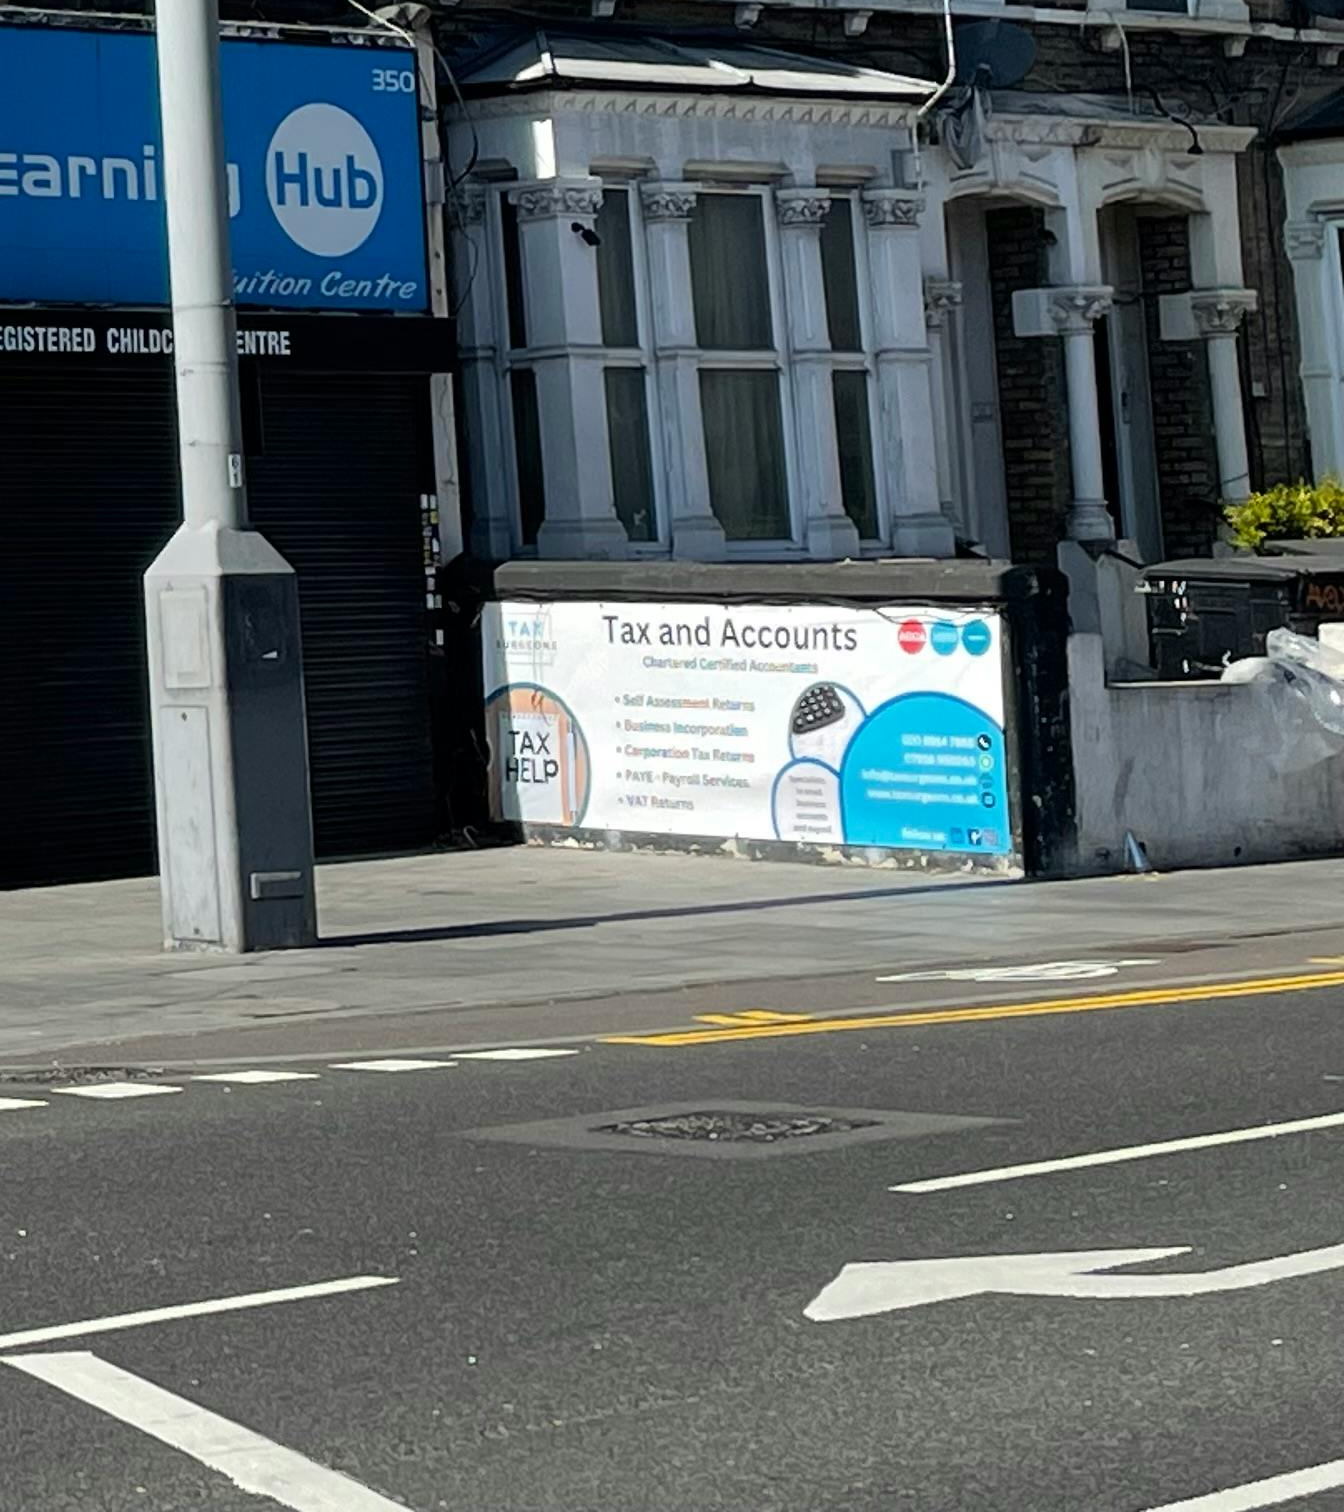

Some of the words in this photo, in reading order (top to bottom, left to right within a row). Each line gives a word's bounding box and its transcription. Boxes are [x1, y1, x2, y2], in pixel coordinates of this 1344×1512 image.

[372, 68, 415, 92] 350
[274, 151, 378, 210] Hub
[232, 268, 312, 296] uition
[320, 270, 418, 300] Centre
[106, 327, 174, 354] CHILDC
[237, 330, 292, 356] ENTRE
[507, 619, 544, 638] TAX
[602, 615, 652, 646] Tax
[658, 616, 711, 647] and
[719, 618, 858, 652] Accounts
[642, 655, 698, 670] Chartered
[699, 657, 747, 672] Certified
[749, 660, 818, 674] Accountants
[623, 694, 644, 707] Self
[646, 695, 710, 709] Assessment
[712, 697, 755, 712] Returns
[624, 719, 671, 734] Business
[673, 721, 748, 737] Incorporation
[508, 730, 551, 756] TAX
[624, 744, 689, 761] Corporation
[691, 747, 710, 761] Tax
[712, 749, 755, 763] Returns
[505, 757, 560, 784] HELP
[625, 769, 654, 783] PAYE
[662, 771, 701, 788] Payroll
[626, 794, 649, 808] VAT
[650, 795, 694, 811] Returns
